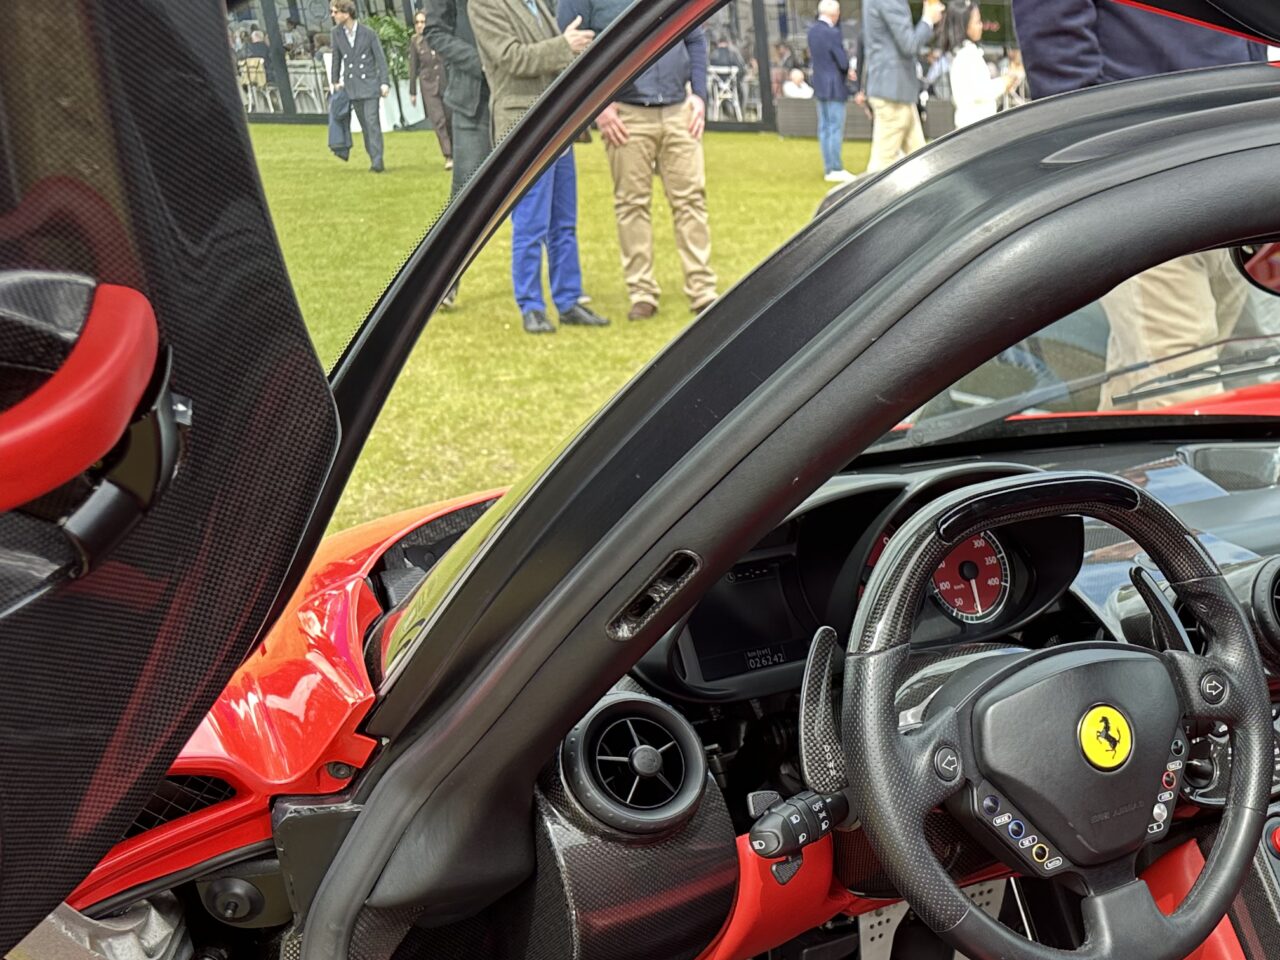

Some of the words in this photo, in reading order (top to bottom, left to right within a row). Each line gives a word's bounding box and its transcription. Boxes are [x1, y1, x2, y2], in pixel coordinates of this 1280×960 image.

[972, 538, 985, 549] 300
[984, 555, 997, 566] 350
[939, 580, 951, 591] 100
[987, 576, 1000, 587] 400
[954, 597, 963, 607] 50
[749, 652, 785, 669] 026242
[812, 800, 824, 812] OFF
